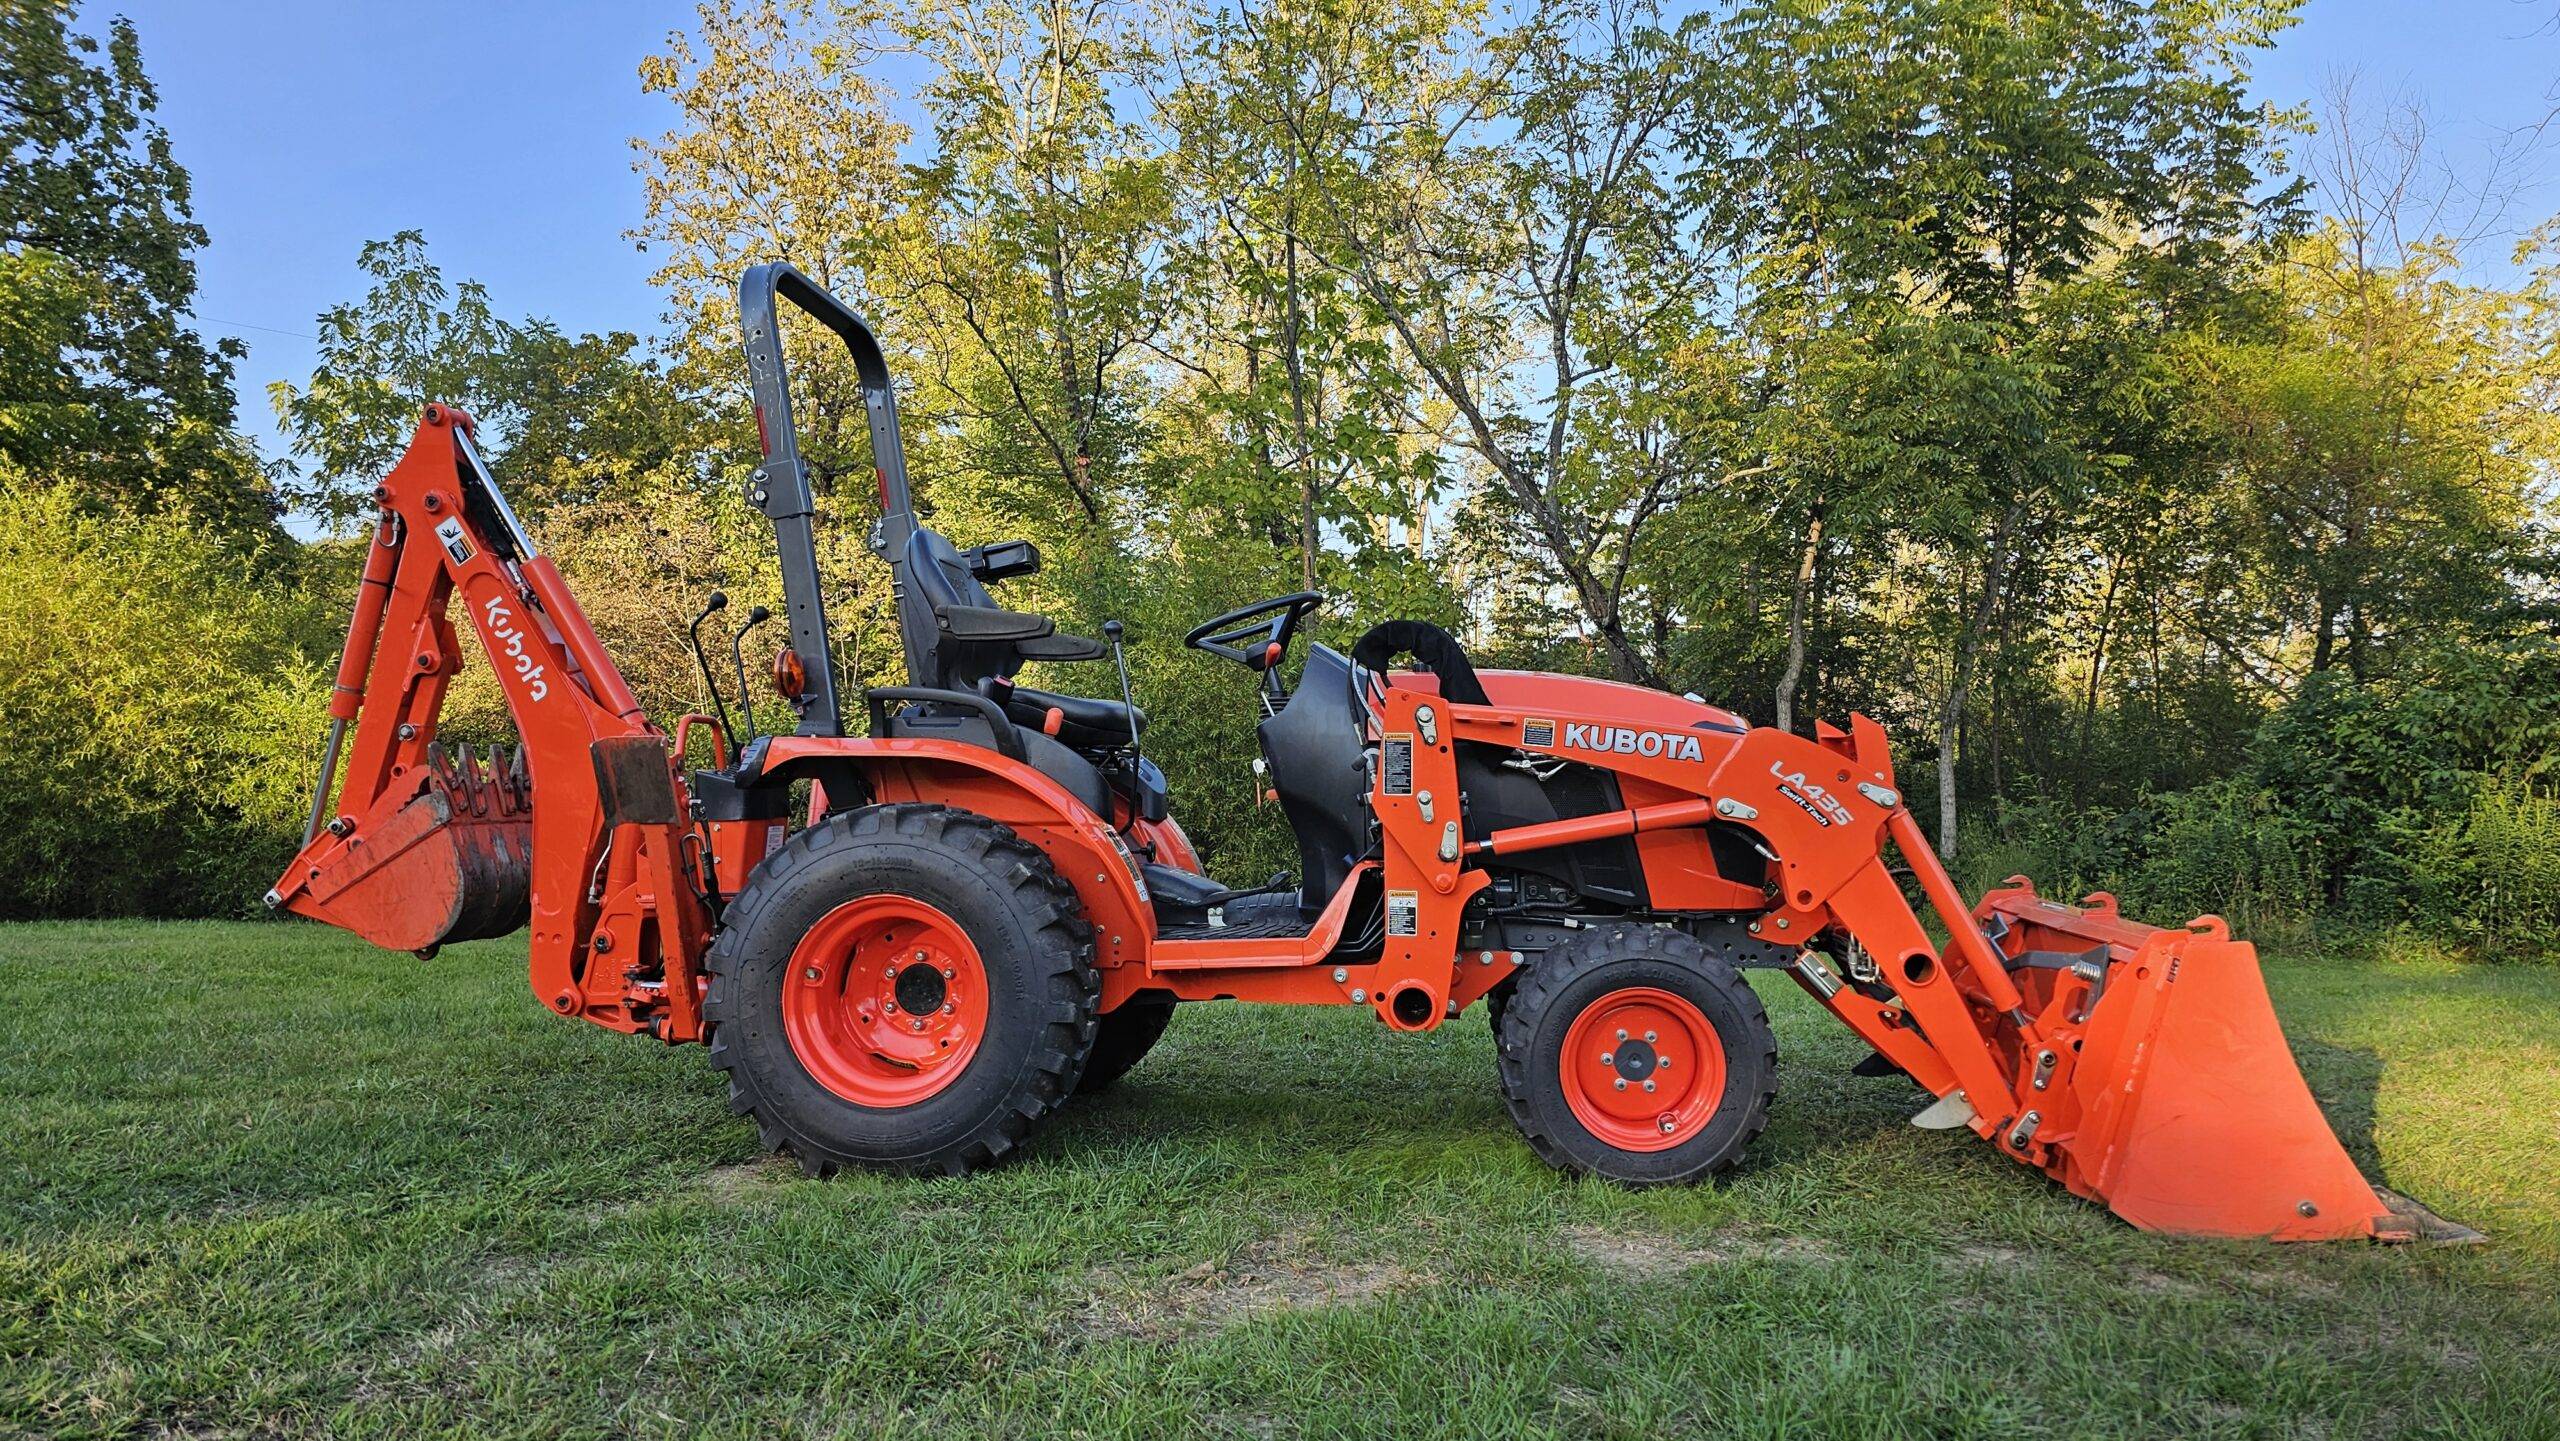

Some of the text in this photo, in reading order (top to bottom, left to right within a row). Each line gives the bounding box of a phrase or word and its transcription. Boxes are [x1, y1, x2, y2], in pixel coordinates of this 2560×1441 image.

[486, 596, 547, 702] Kubota
[1564, 722, 1704, 763] KUBOTA
[1770, 760, 1855, 826] LA435
[1779, 786, 1828, 826] Swift-Tach
